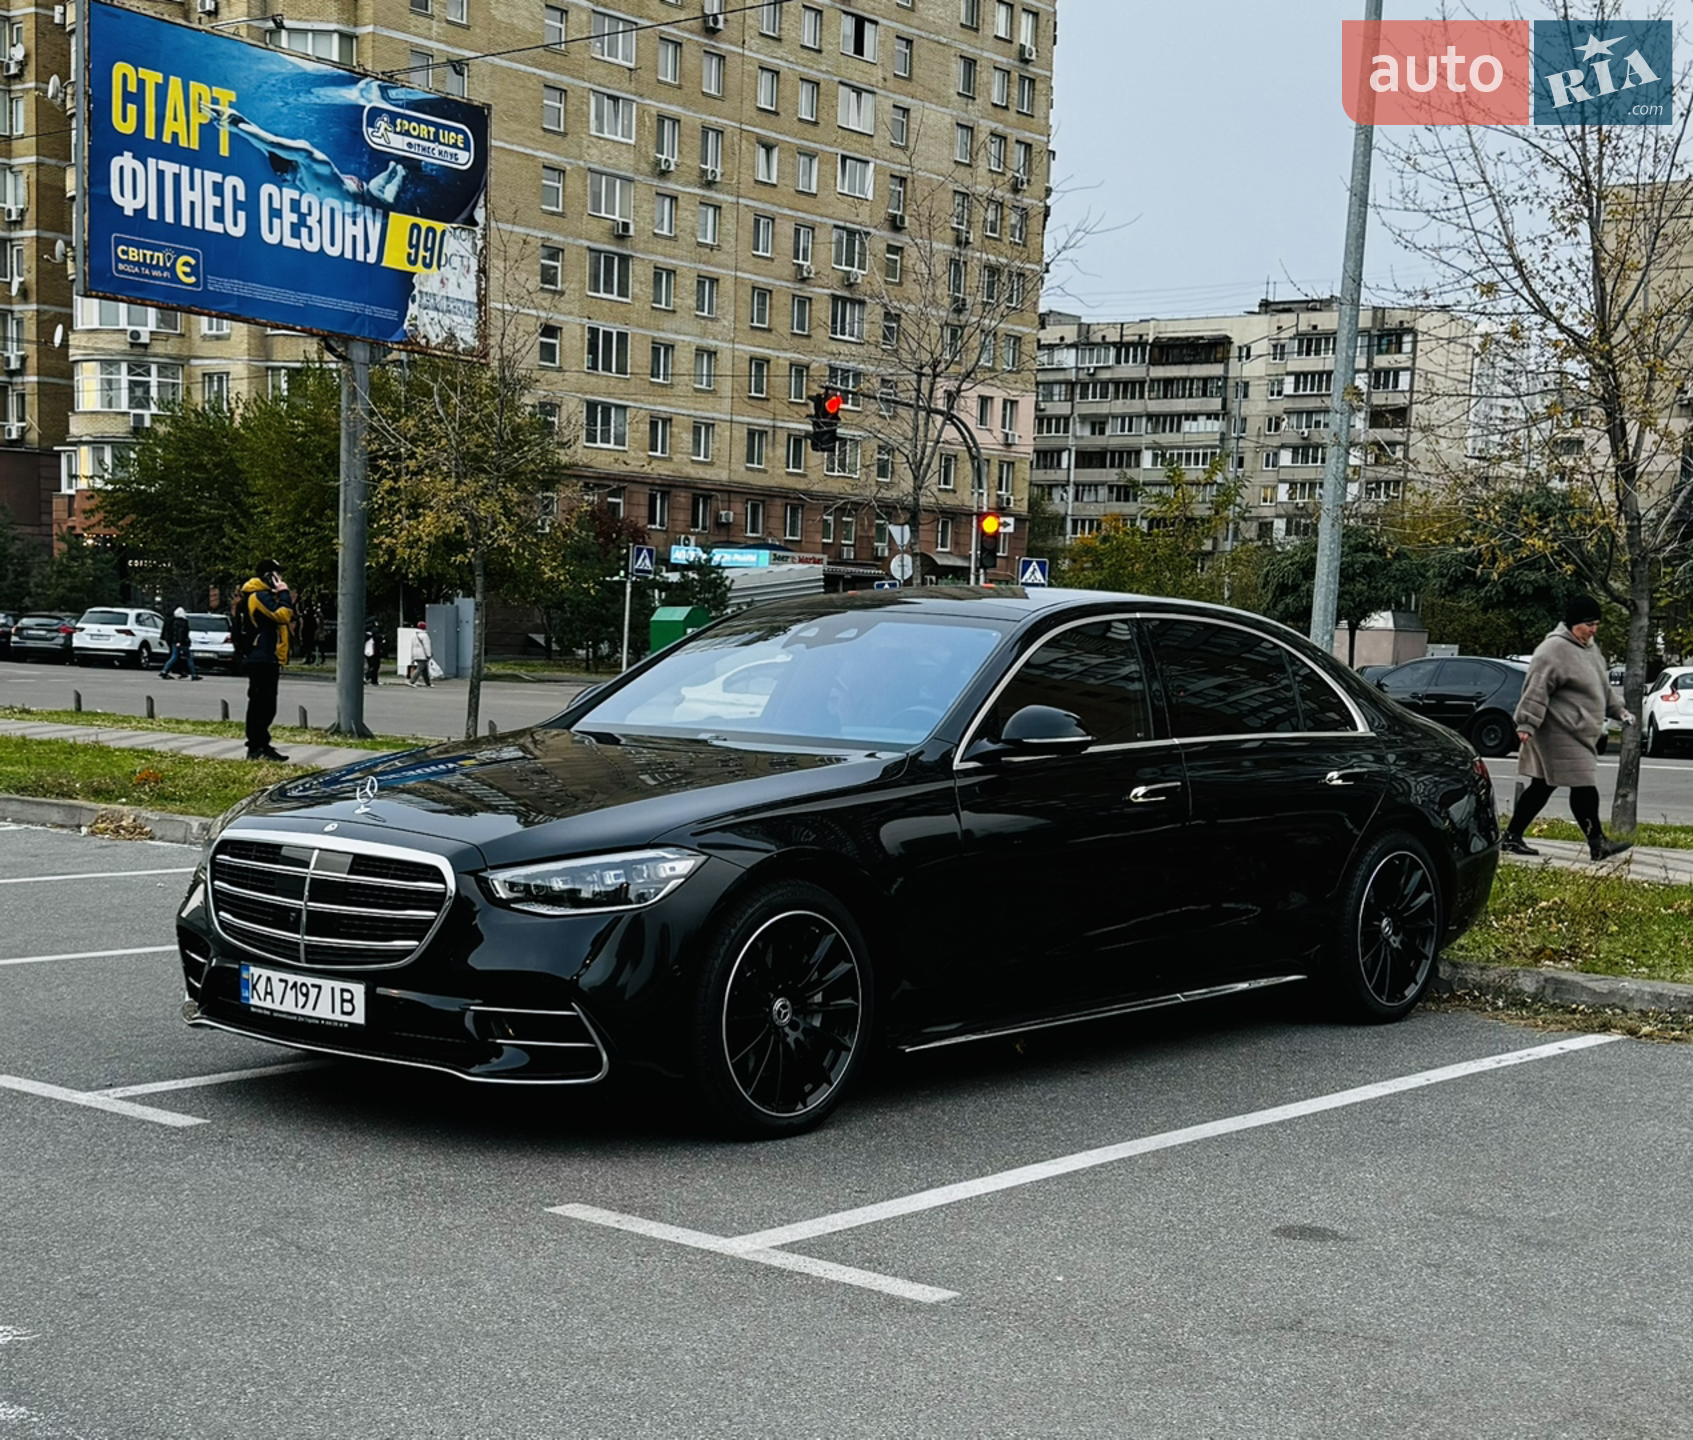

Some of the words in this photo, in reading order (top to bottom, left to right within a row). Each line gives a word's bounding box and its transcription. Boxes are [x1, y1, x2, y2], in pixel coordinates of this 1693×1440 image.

[111, 61, 236, 157] СТАРТ
[395, 118, 436, 141] SPORT
[439, 129, 465, 149] LIFE
[110, 151, 246, 238] ФІТНЕС
[259, 183, 383, 264] СЕЗОНУ
[278, 978, 322, 1012] 7197
